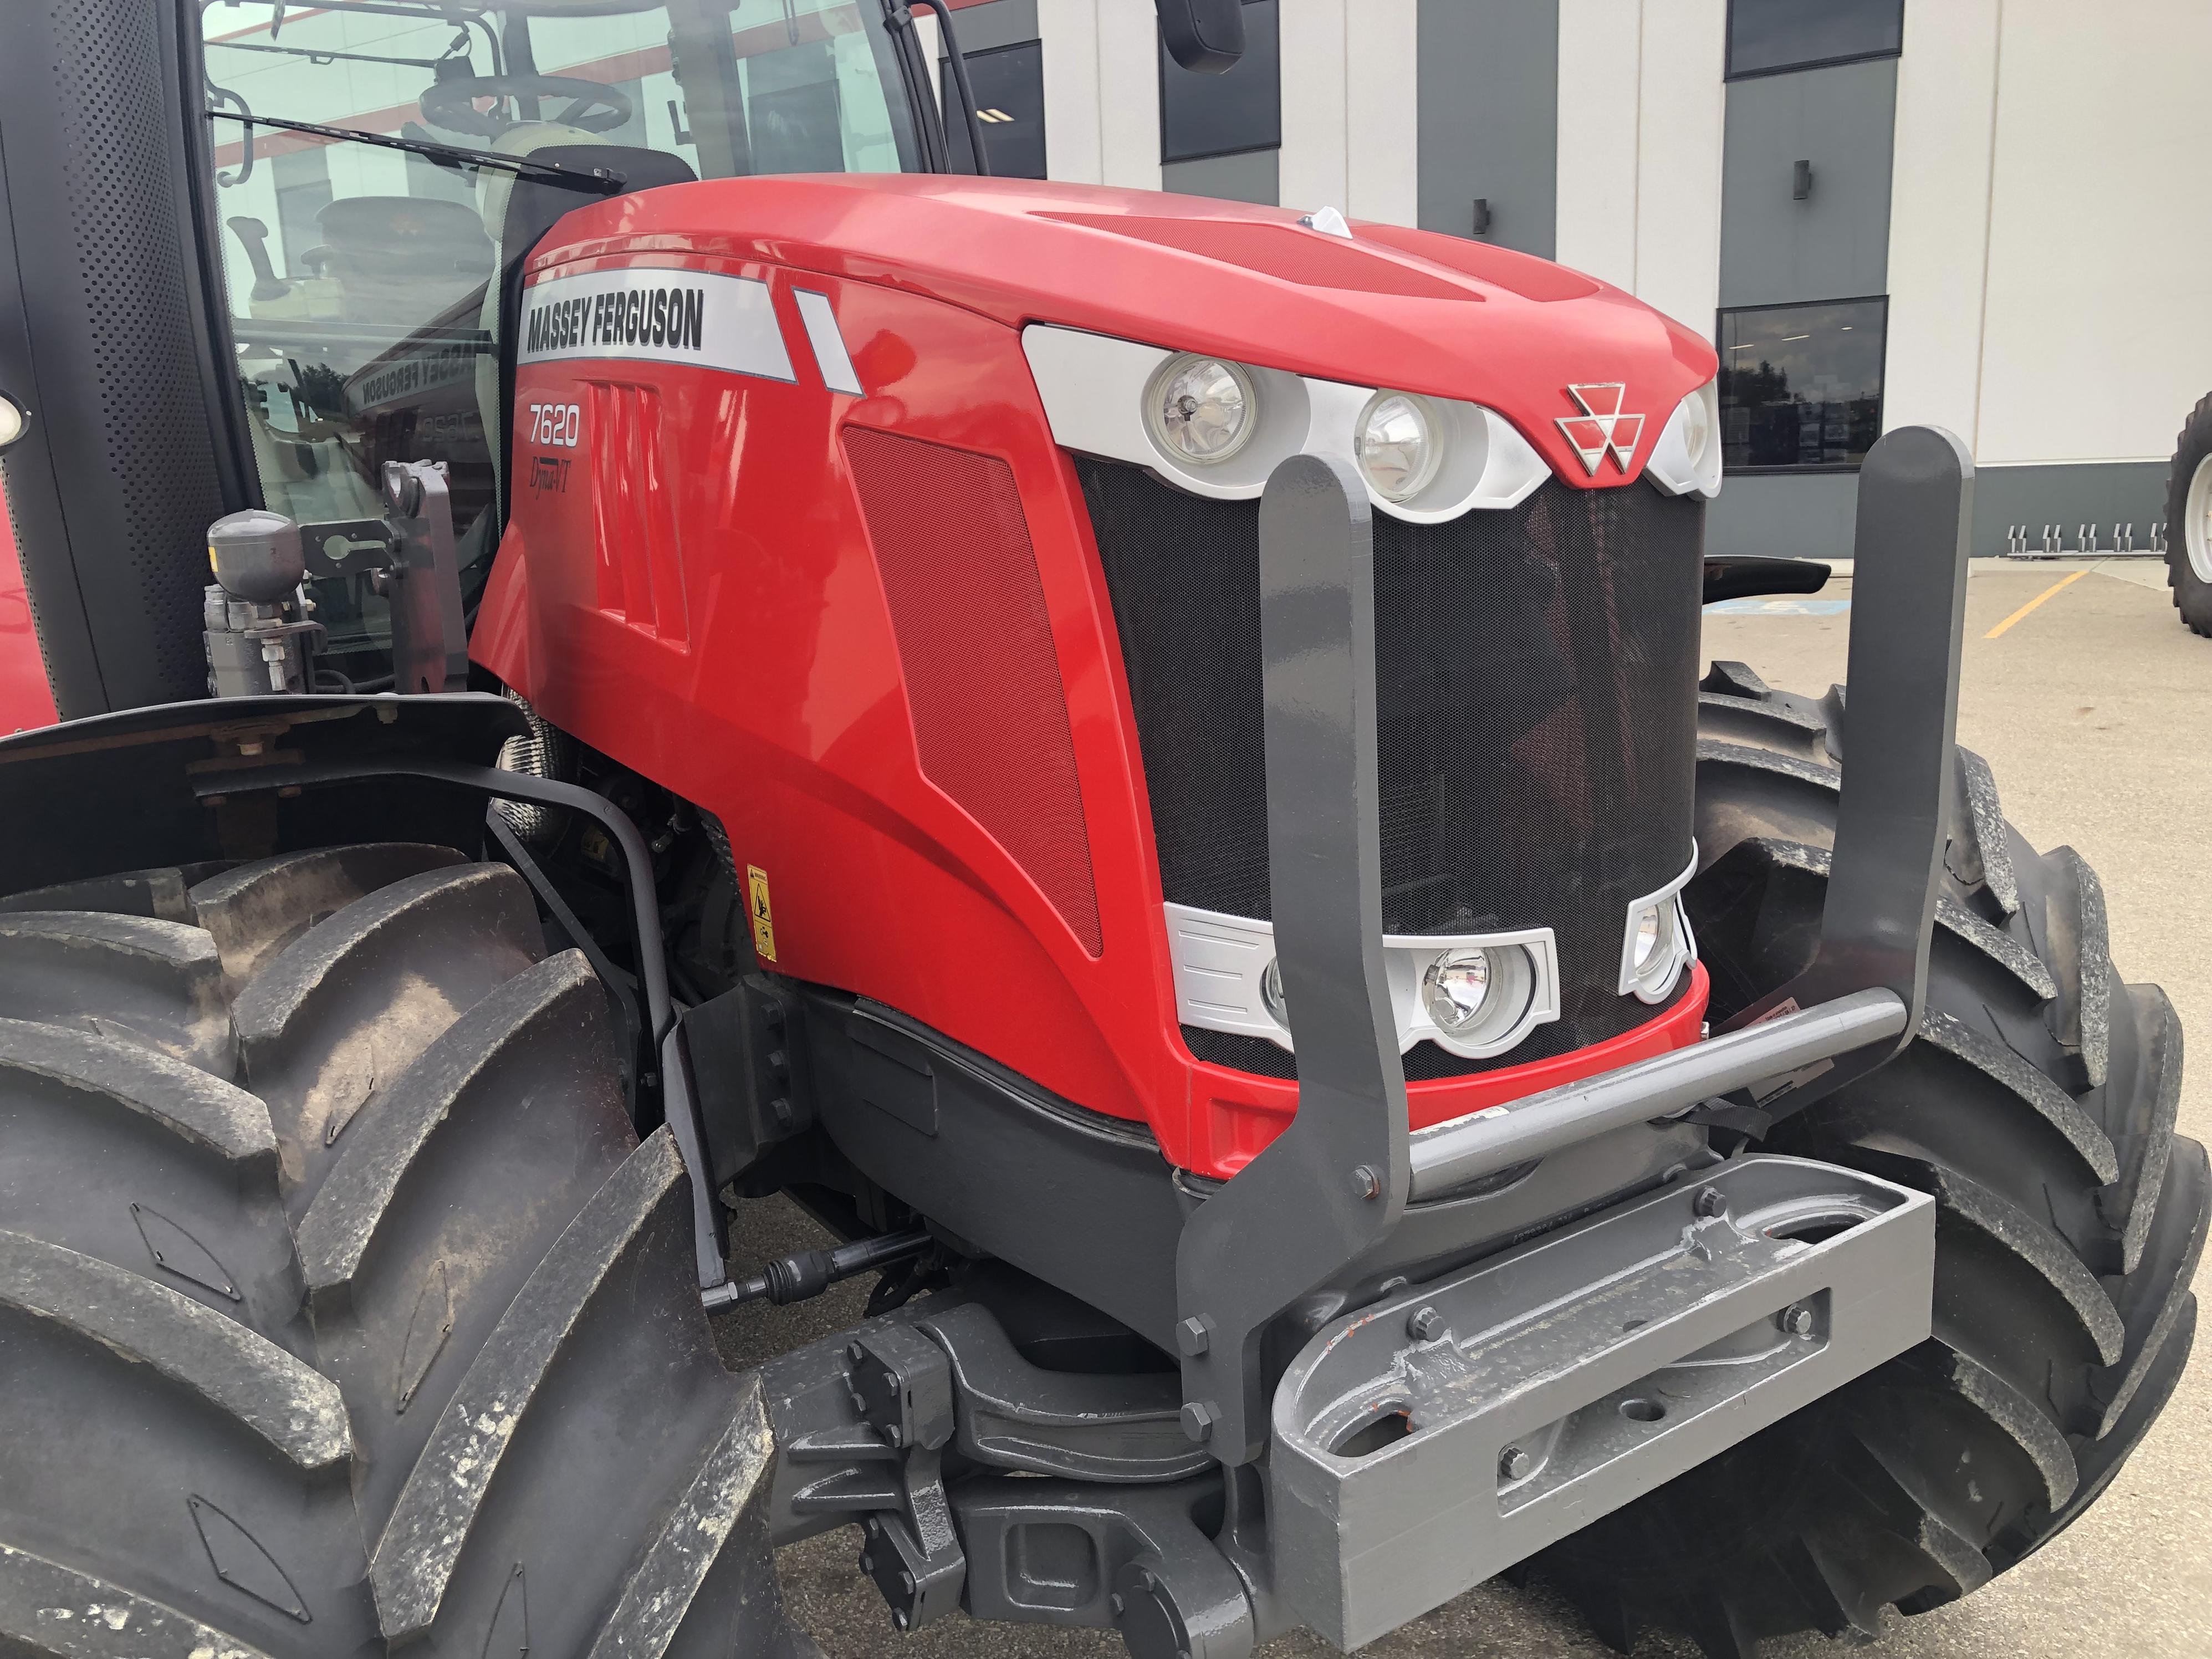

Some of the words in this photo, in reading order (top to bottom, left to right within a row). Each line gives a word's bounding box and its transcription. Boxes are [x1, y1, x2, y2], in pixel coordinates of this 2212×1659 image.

[527, 297, 591, 353] MASSEY
[592, 289, 703, 350] FERGUSON
[530, 404, 580, 448] 7620
